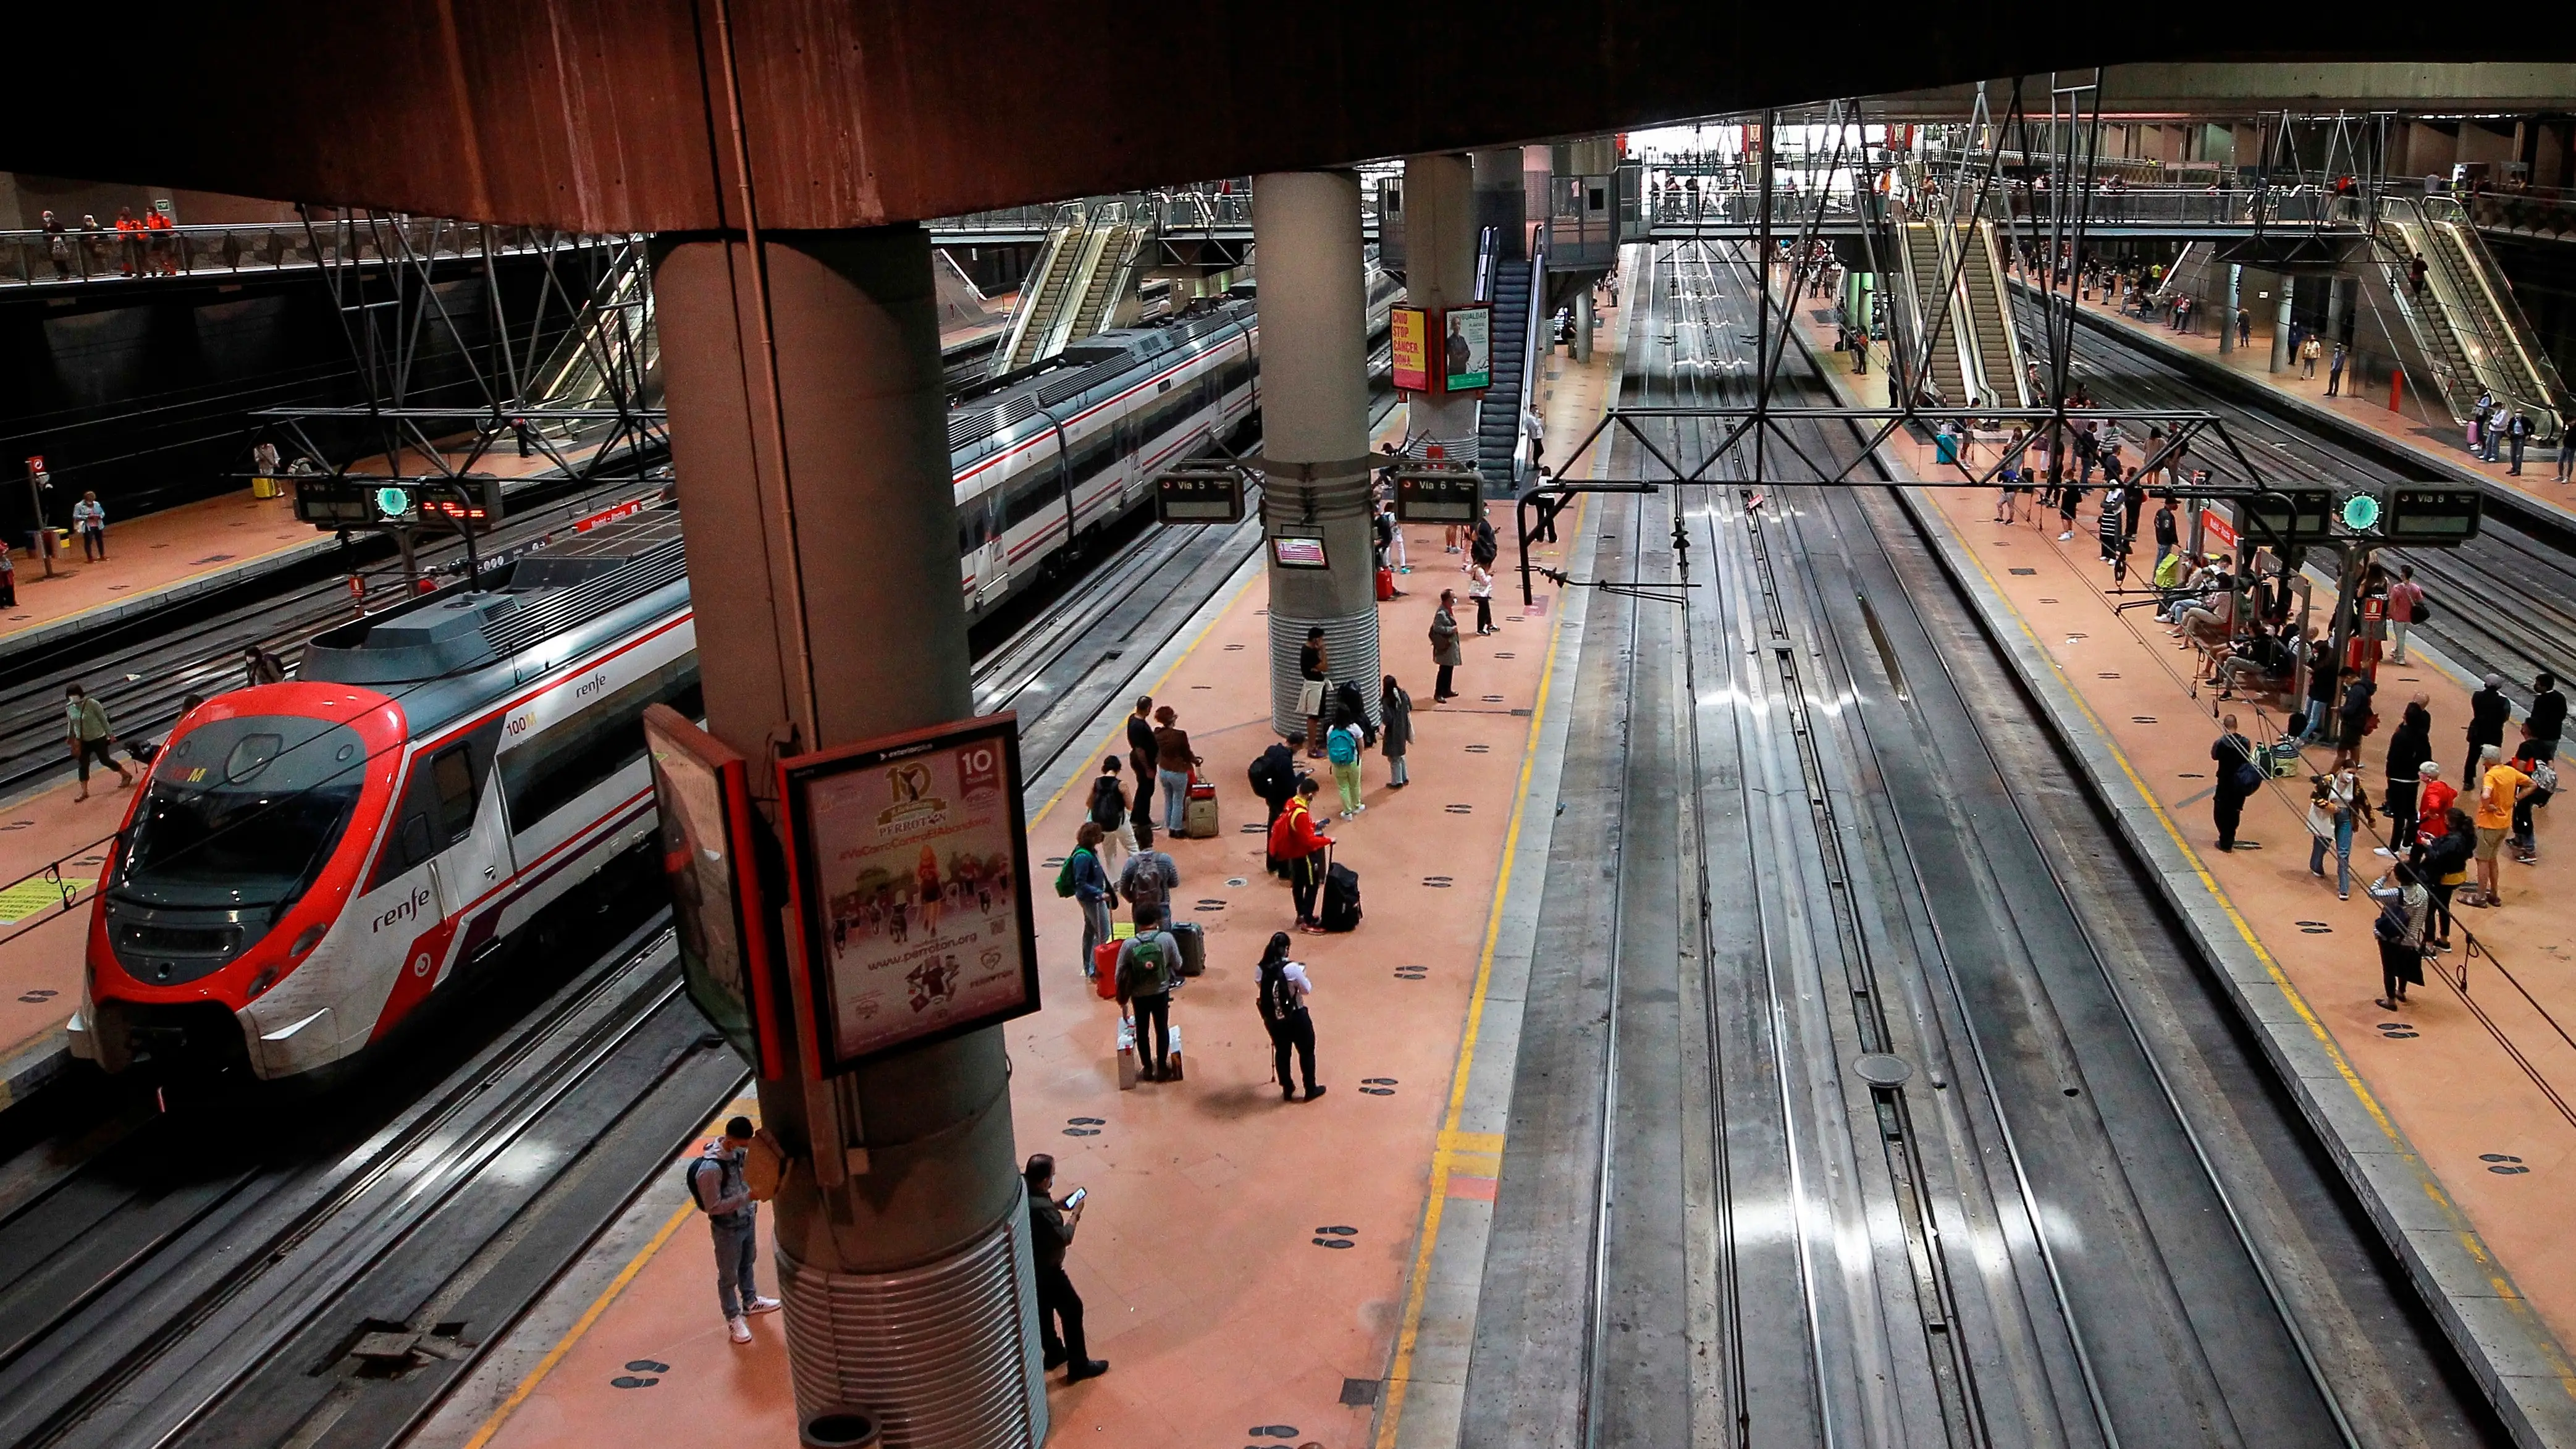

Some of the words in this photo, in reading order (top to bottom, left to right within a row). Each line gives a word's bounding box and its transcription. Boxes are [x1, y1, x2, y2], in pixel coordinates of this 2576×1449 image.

[1393, 326, 1409, 337] STOP
[1199, 481, 1205, 489] 5
[1440, 481, 1446, 489] 6
[2438, 494, 2444, 503] 8
[576, 673, 606, 698] renfe
[507, 712, 537, 736] 100M
[961, 749, 993, 775] 10
[373, 886, 430, 934] renfe
